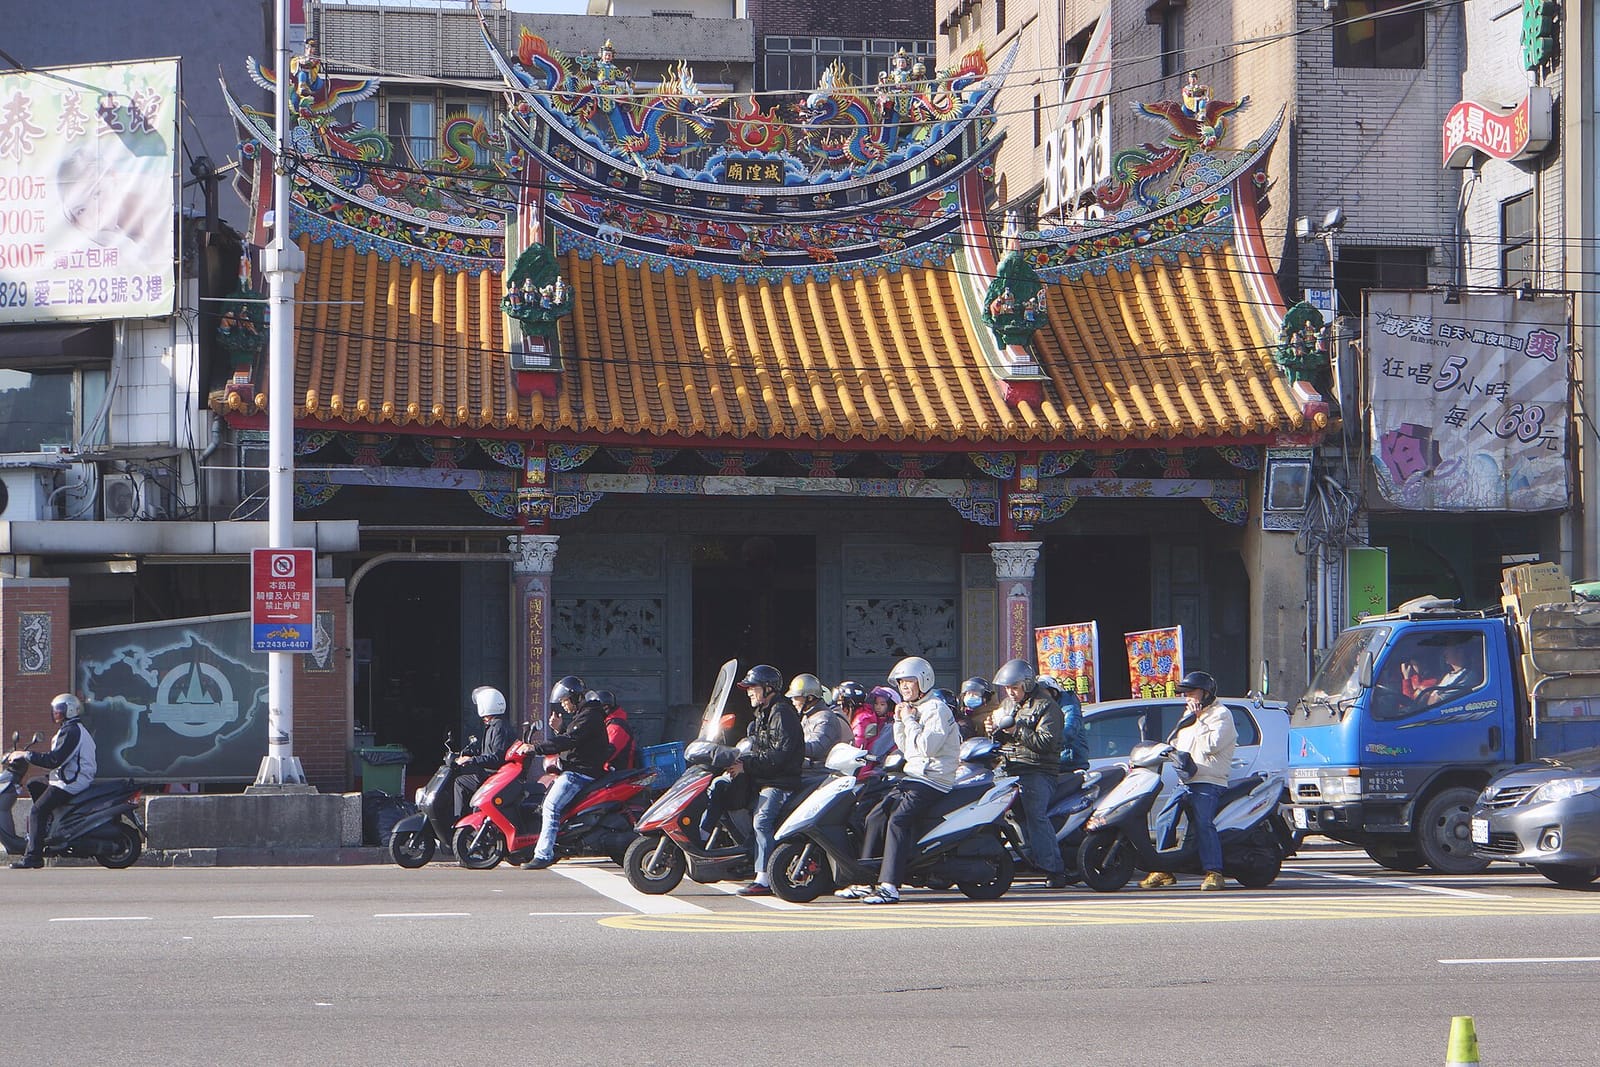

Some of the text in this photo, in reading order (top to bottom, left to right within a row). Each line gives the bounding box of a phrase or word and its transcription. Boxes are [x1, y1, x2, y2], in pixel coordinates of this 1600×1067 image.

[34, 275, 162, 307] 愛二路28號3樓
[1444, 403, 1559, 451] 每人68元
[269, 581, 296, 590] 本路段
[256, 592, 310, 601] 騎樓及人行道
[265, 601, 301, 610] 禁止停車
